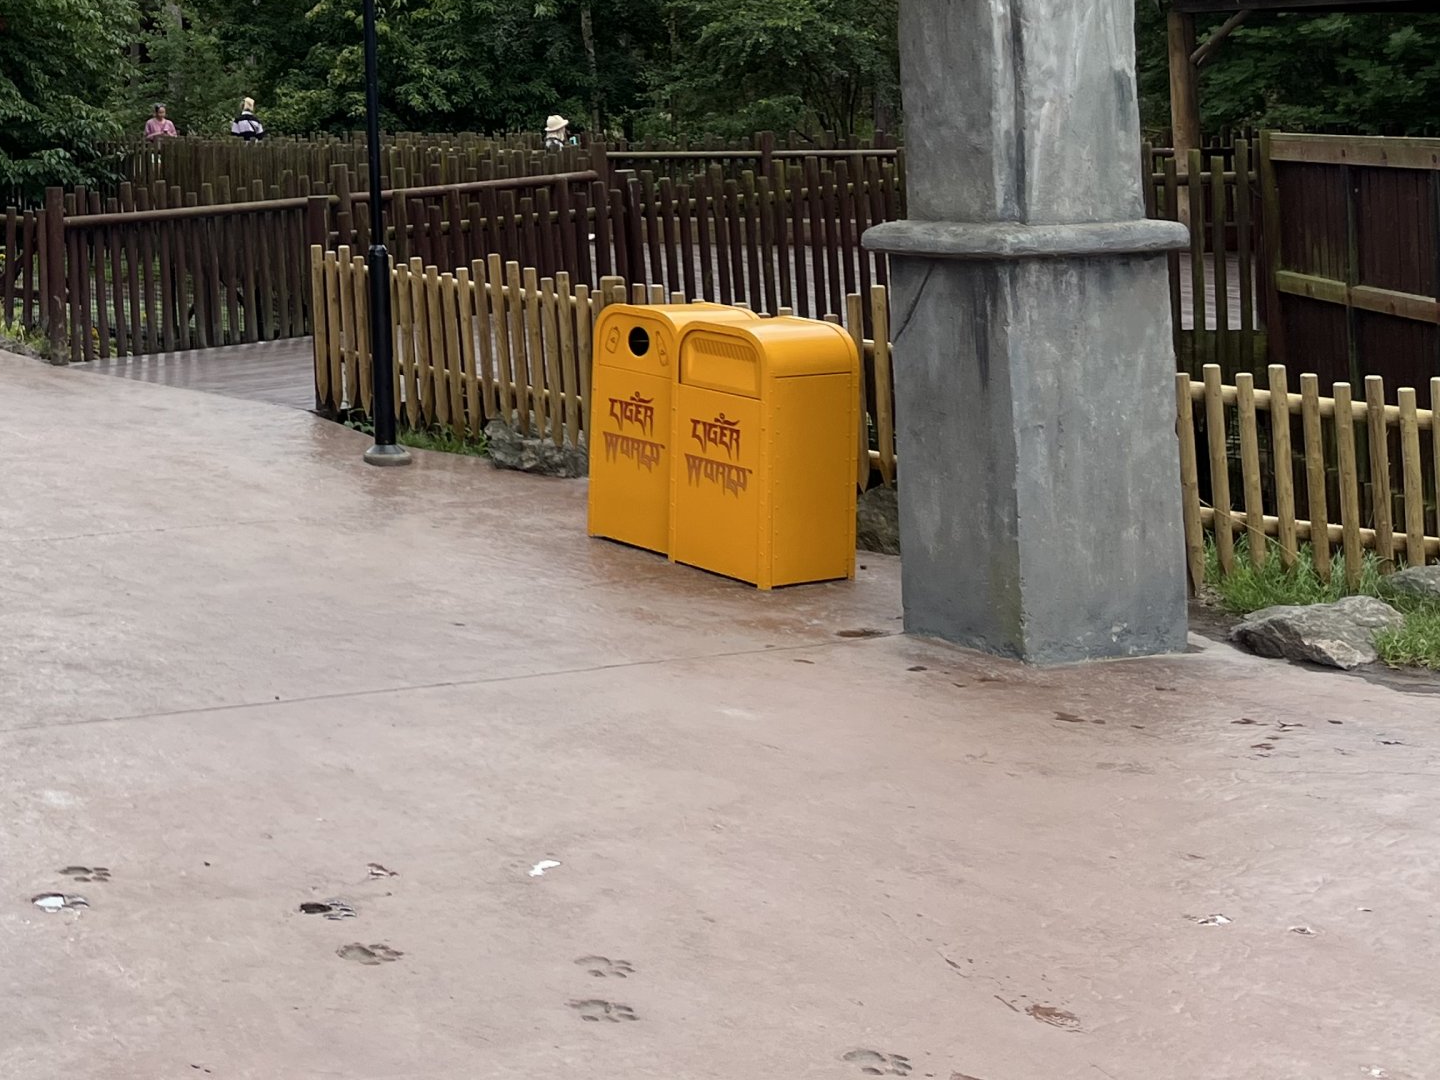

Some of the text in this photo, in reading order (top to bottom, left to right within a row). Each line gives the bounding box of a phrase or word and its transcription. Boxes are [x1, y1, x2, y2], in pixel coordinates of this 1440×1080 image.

[608, 394, 655, 438] TIGER
[602, 431, 666, 474] WORLD
[690, 416, 742, 462] TIGER
[684, 453, 753, 499] WORLD
